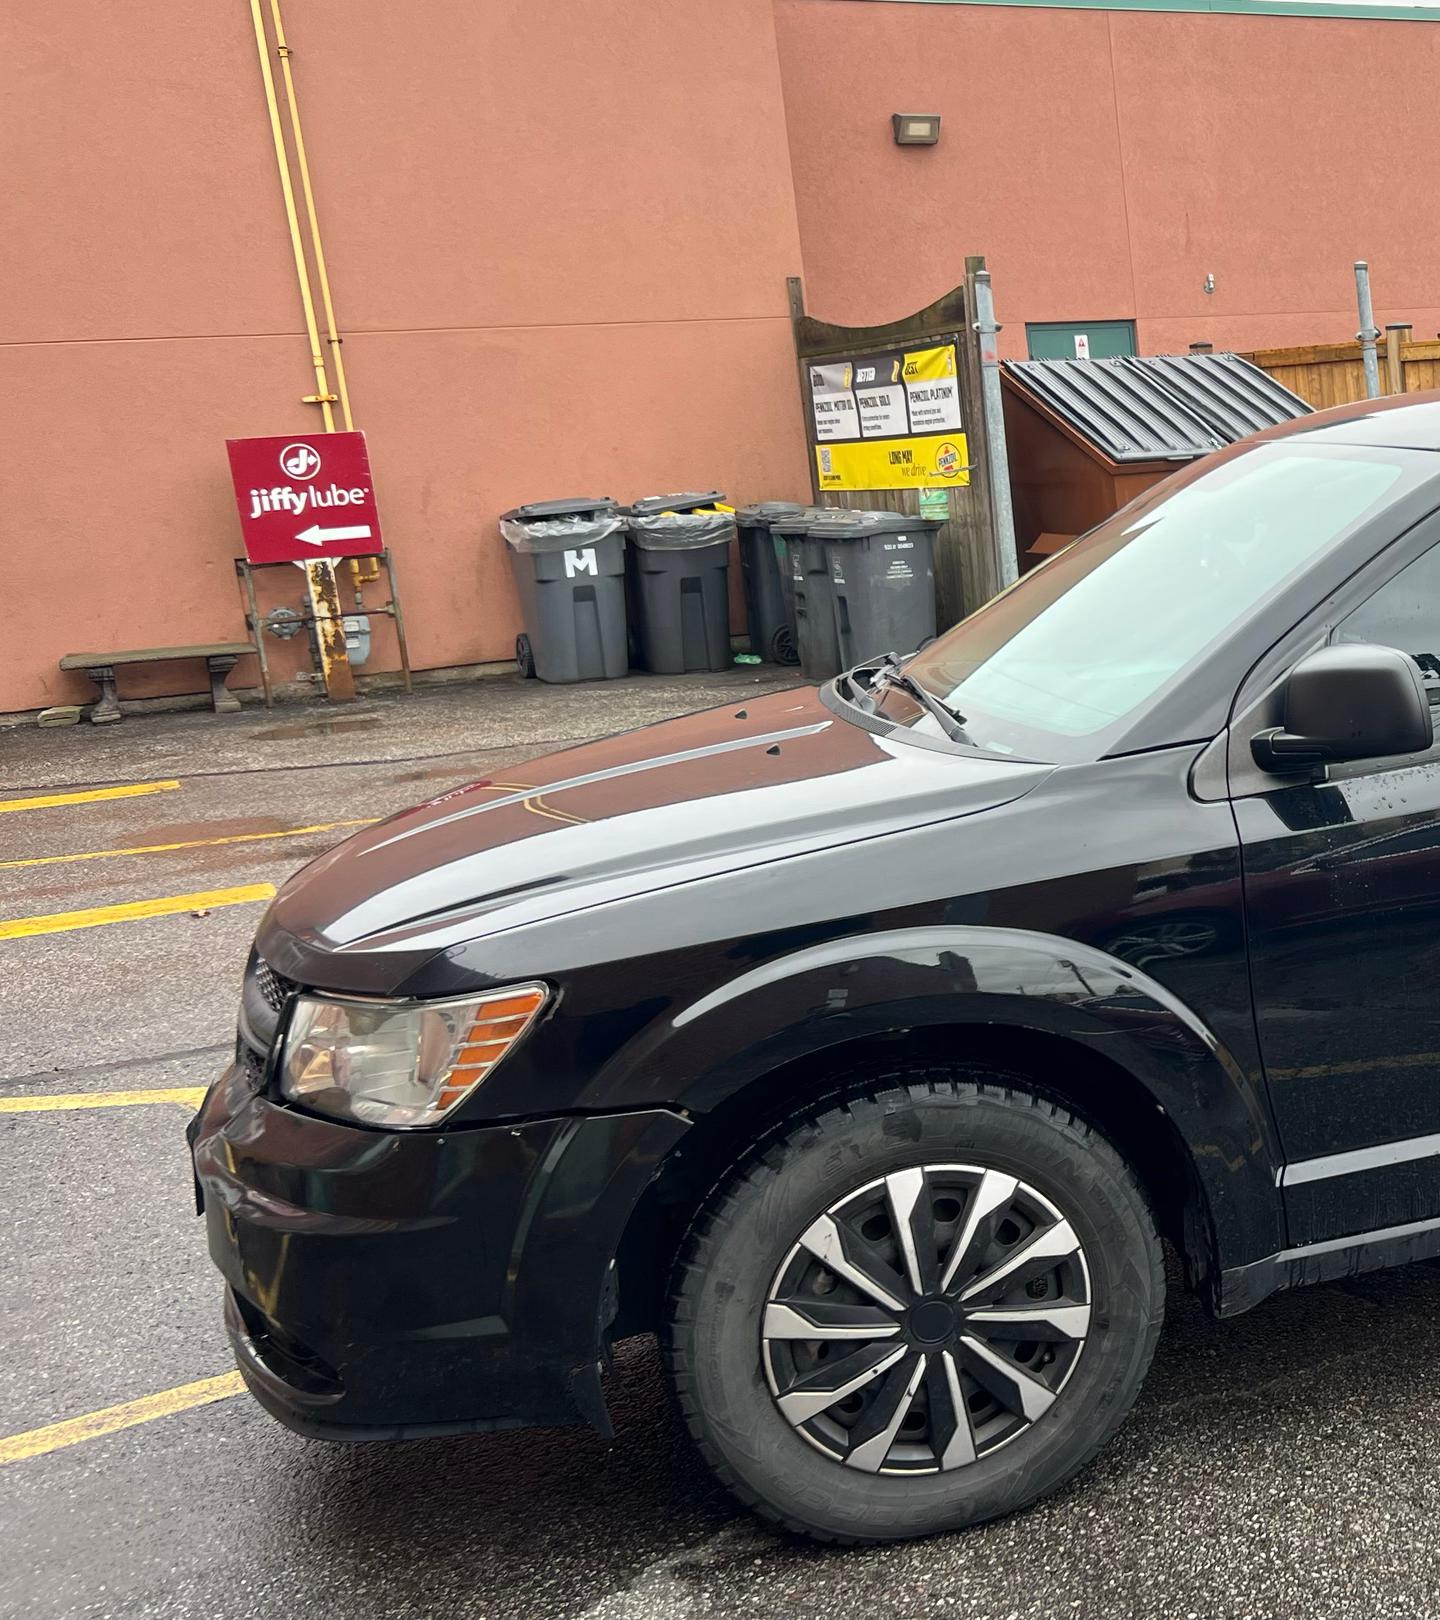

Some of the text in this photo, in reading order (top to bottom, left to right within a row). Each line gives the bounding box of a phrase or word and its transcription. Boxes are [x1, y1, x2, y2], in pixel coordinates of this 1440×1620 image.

[888, 449, 913, 464] LONG MAY
[250, 483, 365, 519] jiffy lube
[564, 548, 599, 578] M
